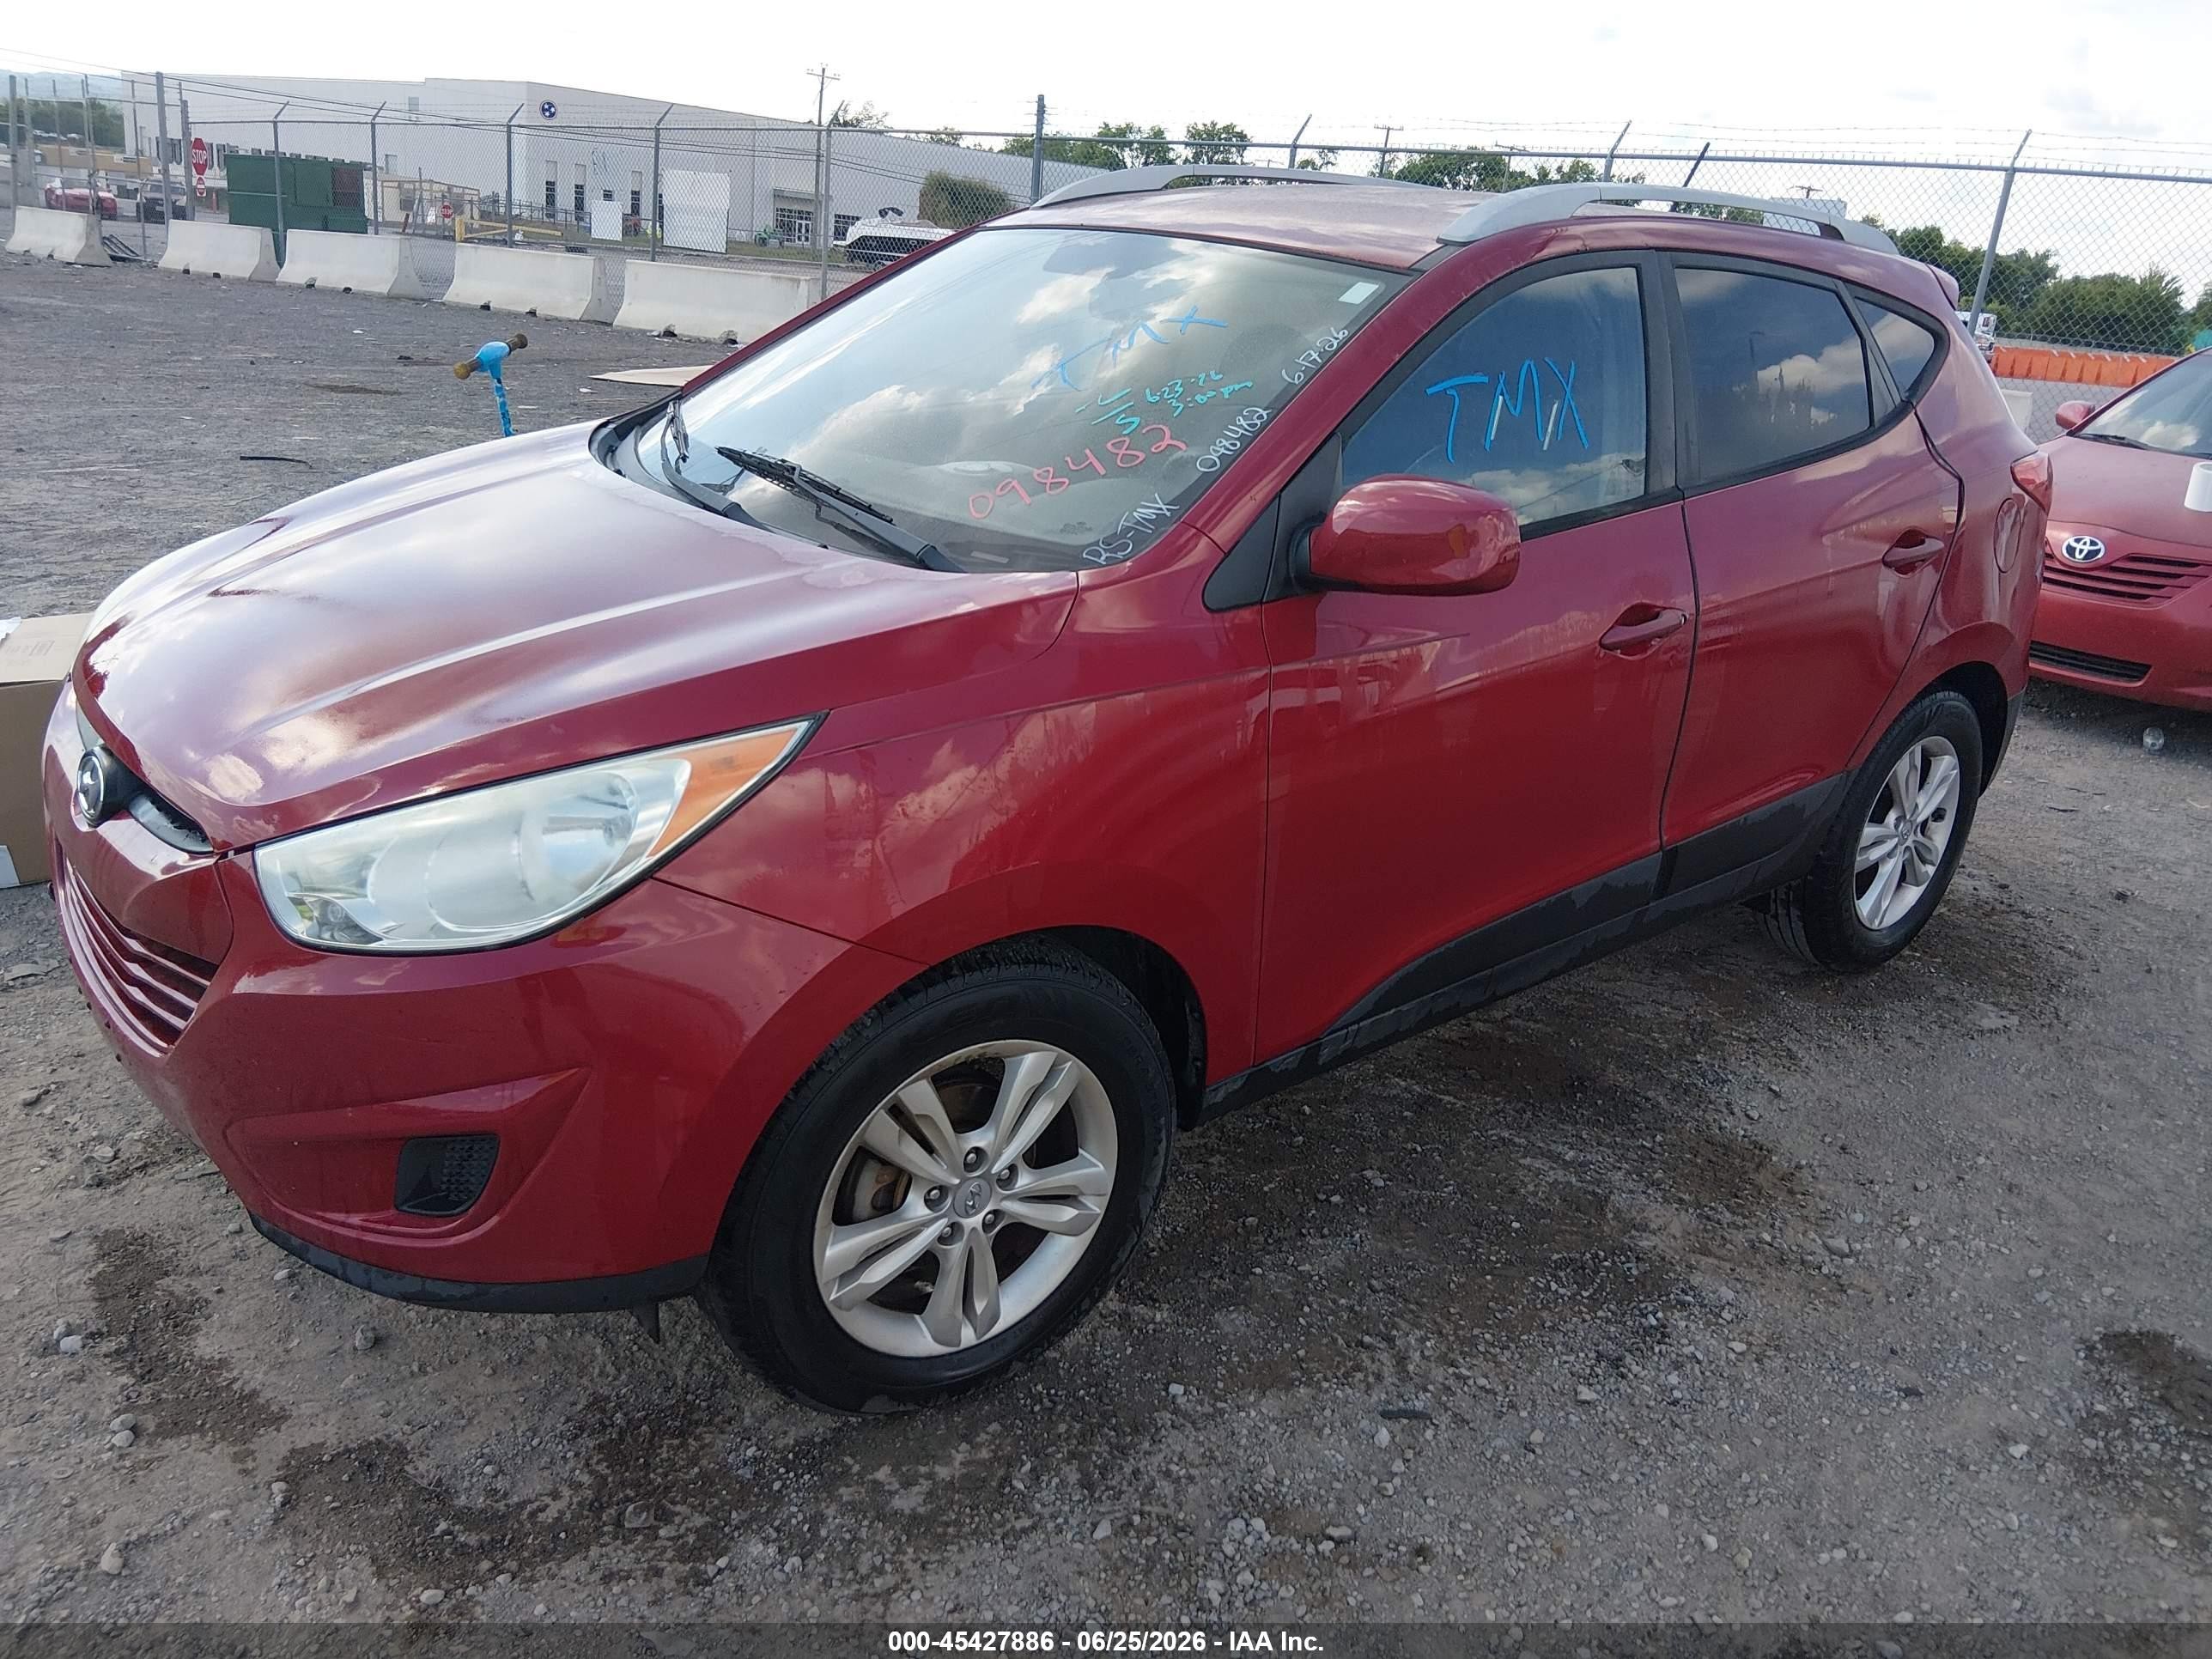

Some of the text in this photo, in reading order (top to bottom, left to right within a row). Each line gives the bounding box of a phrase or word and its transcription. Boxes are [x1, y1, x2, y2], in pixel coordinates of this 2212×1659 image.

[191, 149, 207, 164] STOP
[1030, 306, 1229, 392] TMX
[1196, 406, 1273, 472] 098482
[1425, 356, 1589, 464] TMX
[969, 423, 1188, 520] 098482
[1082, 492, 1181, 565] RS-TMX
